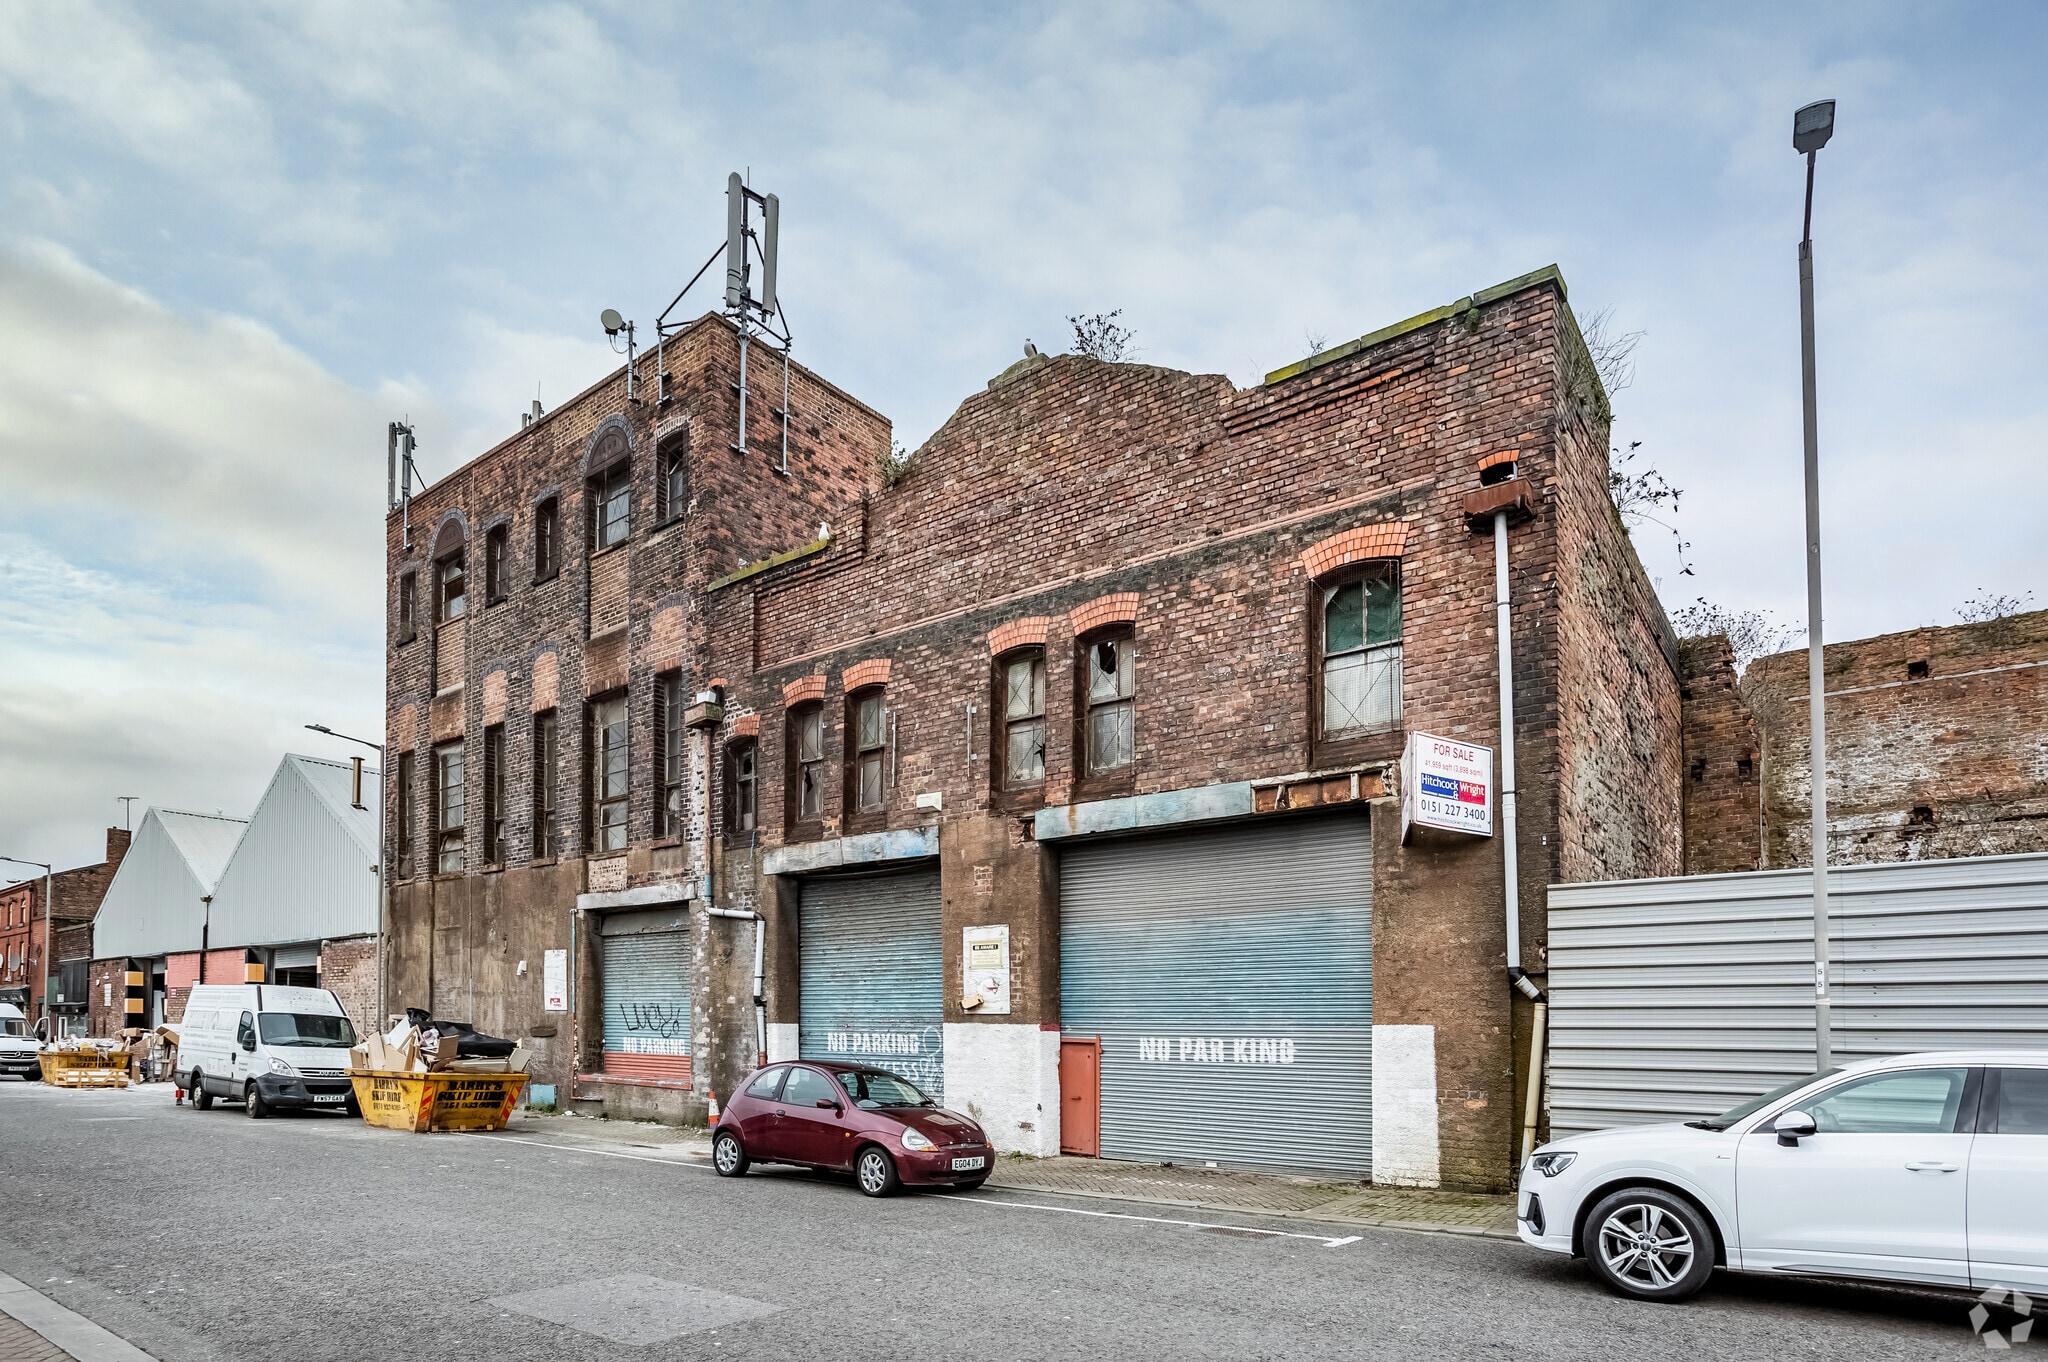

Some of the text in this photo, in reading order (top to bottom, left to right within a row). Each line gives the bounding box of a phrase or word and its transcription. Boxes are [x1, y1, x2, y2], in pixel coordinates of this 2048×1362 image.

[1433, 743, 1474, 762] FOR SALE
[1421, 773, 1485, 797] Hitchcock Wright
[1453, 791, 1459, 800] &
[1421, 799, 1486, 821] 0151 227 3400
[623, 1036, 638, 1053] NO
[640, 1038, 685, 1056] PARKING
[827, 1032, 920, 1054] NO PARKING
[1139, 1037, 1295, 1064] NO PAR KING
[373, 1079, 399, 1090] BARRY'S
[448, 1081, 504, 1091] BARRY'S
[371, 1091, 402, 1102] SKIP HIRE
[437, 1091, 506, 1101] SKIP HIRE
[954, 1158, 983, 1169] EG04 DYJ
